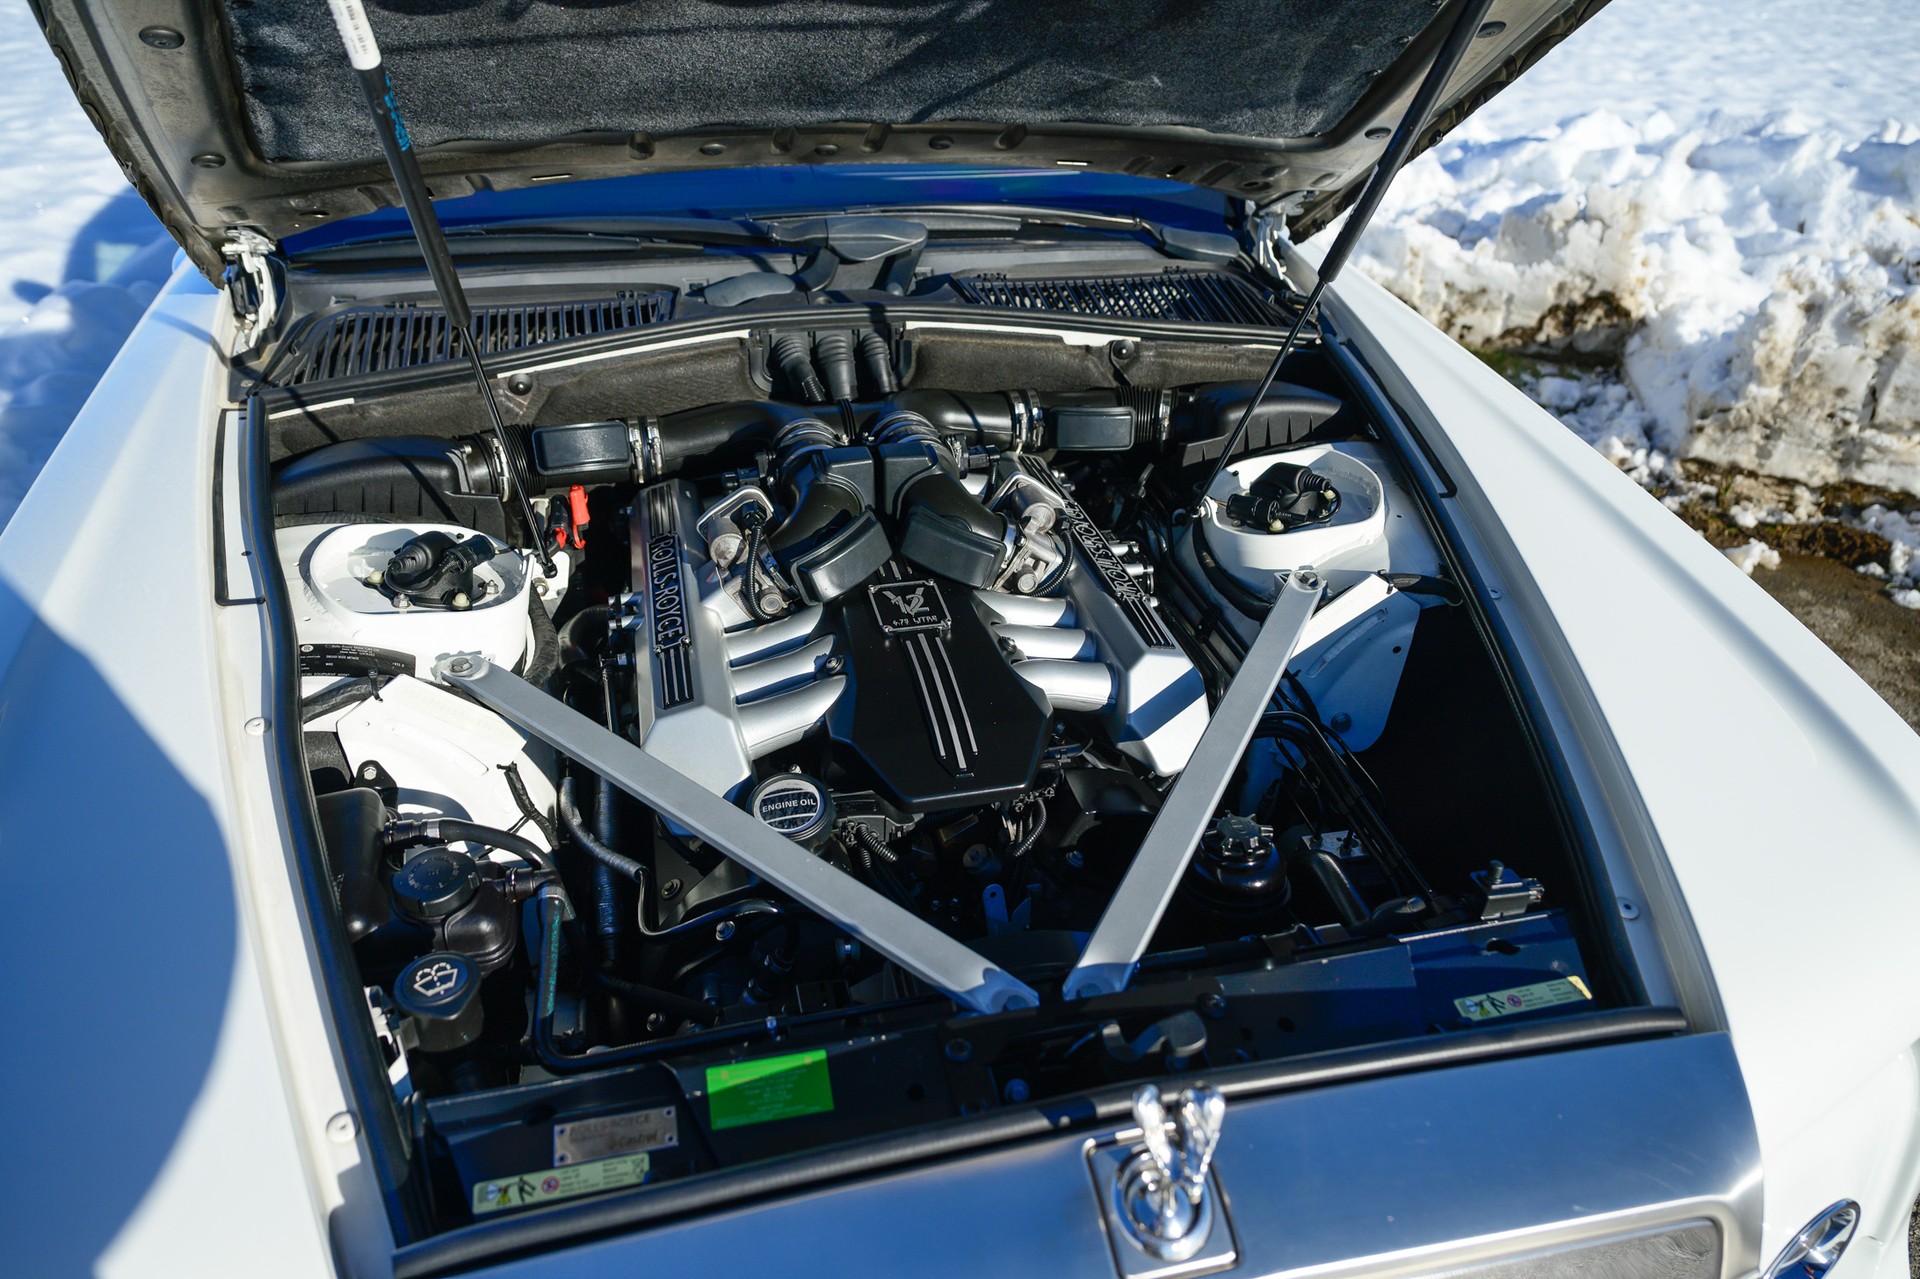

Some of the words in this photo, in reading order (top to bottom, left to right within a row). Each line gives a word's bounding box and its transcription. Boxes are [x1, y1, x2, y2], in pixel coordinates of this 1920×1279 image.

[651, 538, 683, 641] ROLLS-ROYCE
[762, 800, 798, 813] ENGINE
[800, 798, 816, 806] OIL
